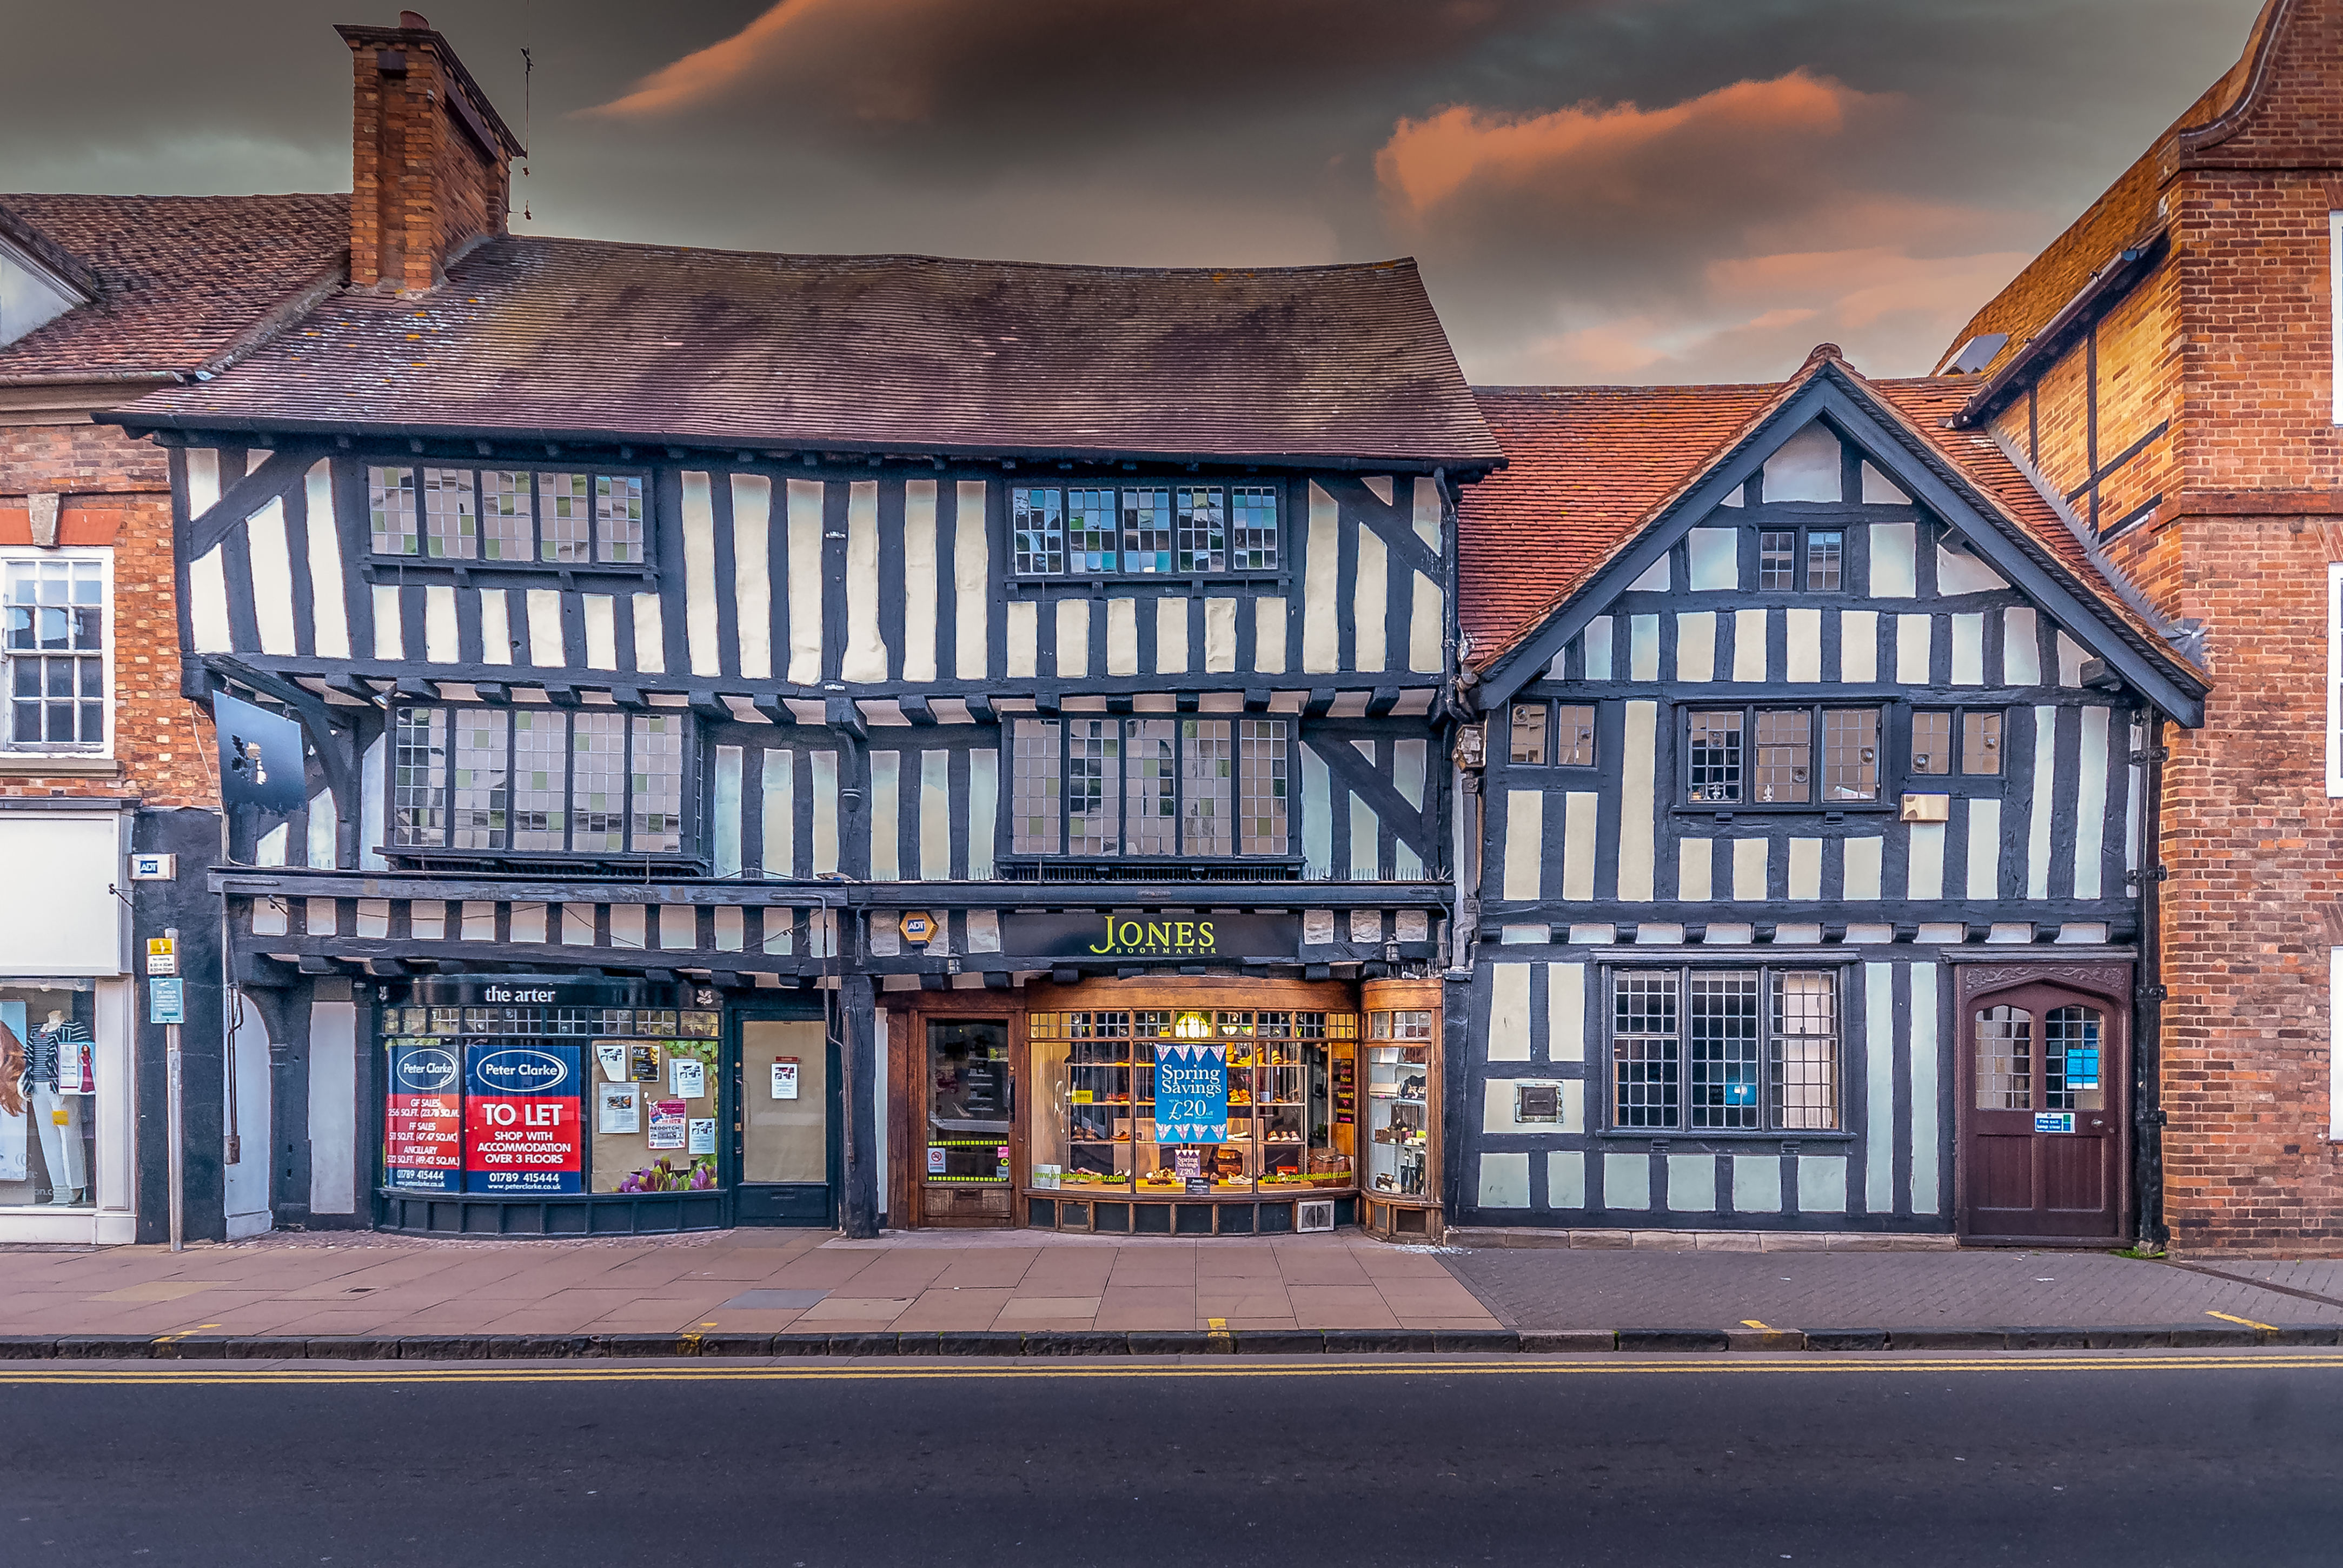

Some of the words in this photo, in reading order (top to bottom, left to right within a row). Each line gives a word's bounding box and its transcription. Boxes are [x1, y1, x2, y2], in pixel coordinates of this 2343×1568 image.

[140, 862, 157, 872] ADT
[908, 921, 925, 929] ADT
[1090, 916, 1214, 953] JONES
[484, 986, 512, 1002] the
[515, 988, 556, 1002] arter
[403, 1063, 425, 1073] Peter
[426, 1062, 453, 1073] Clarke
[486, 1064, 515, 1075] Peter
[519, 1064, 557, 1075] Clarke
[1162, 1064, 1220, 1084] Spring
[1162, 1079, 1222, 1098] Savings
[410, 1099, 420, 1107] GF
[421, 1099, 440, 1107] SALES
[388, 1108, 400, 1117] 256
[482, 1104, 516, 1126] TO
[525, 1104, 563, 1126] LET
[1169, 1100, 1206, 1120] £20
[409, 1122, 416, 1130] FF
[494, 1131, 523, 1141] SHOP
[526, 1132, 553, 1141] WITH
[403, 1146, 438, 1154] ANCILLARY
[477, 1142, 571, 1152] ACCOMMODATION
[415, 1156, 434, 1165] (49.42
[485, 1154, 513, 1163] OVER
[515, 1154, 522, 1163] 3
[525, 1154, 563, 1164] FLOORS
[397, 1170, 415, 1179] 01789
[417, 1171, 444, 1179] 415444
[489, 1173, 519, 1182] 01789
[523, 1173, 560, 1182] 415444
[1263, 1171, 1352, 1182] wwwonesbootmaker.com
